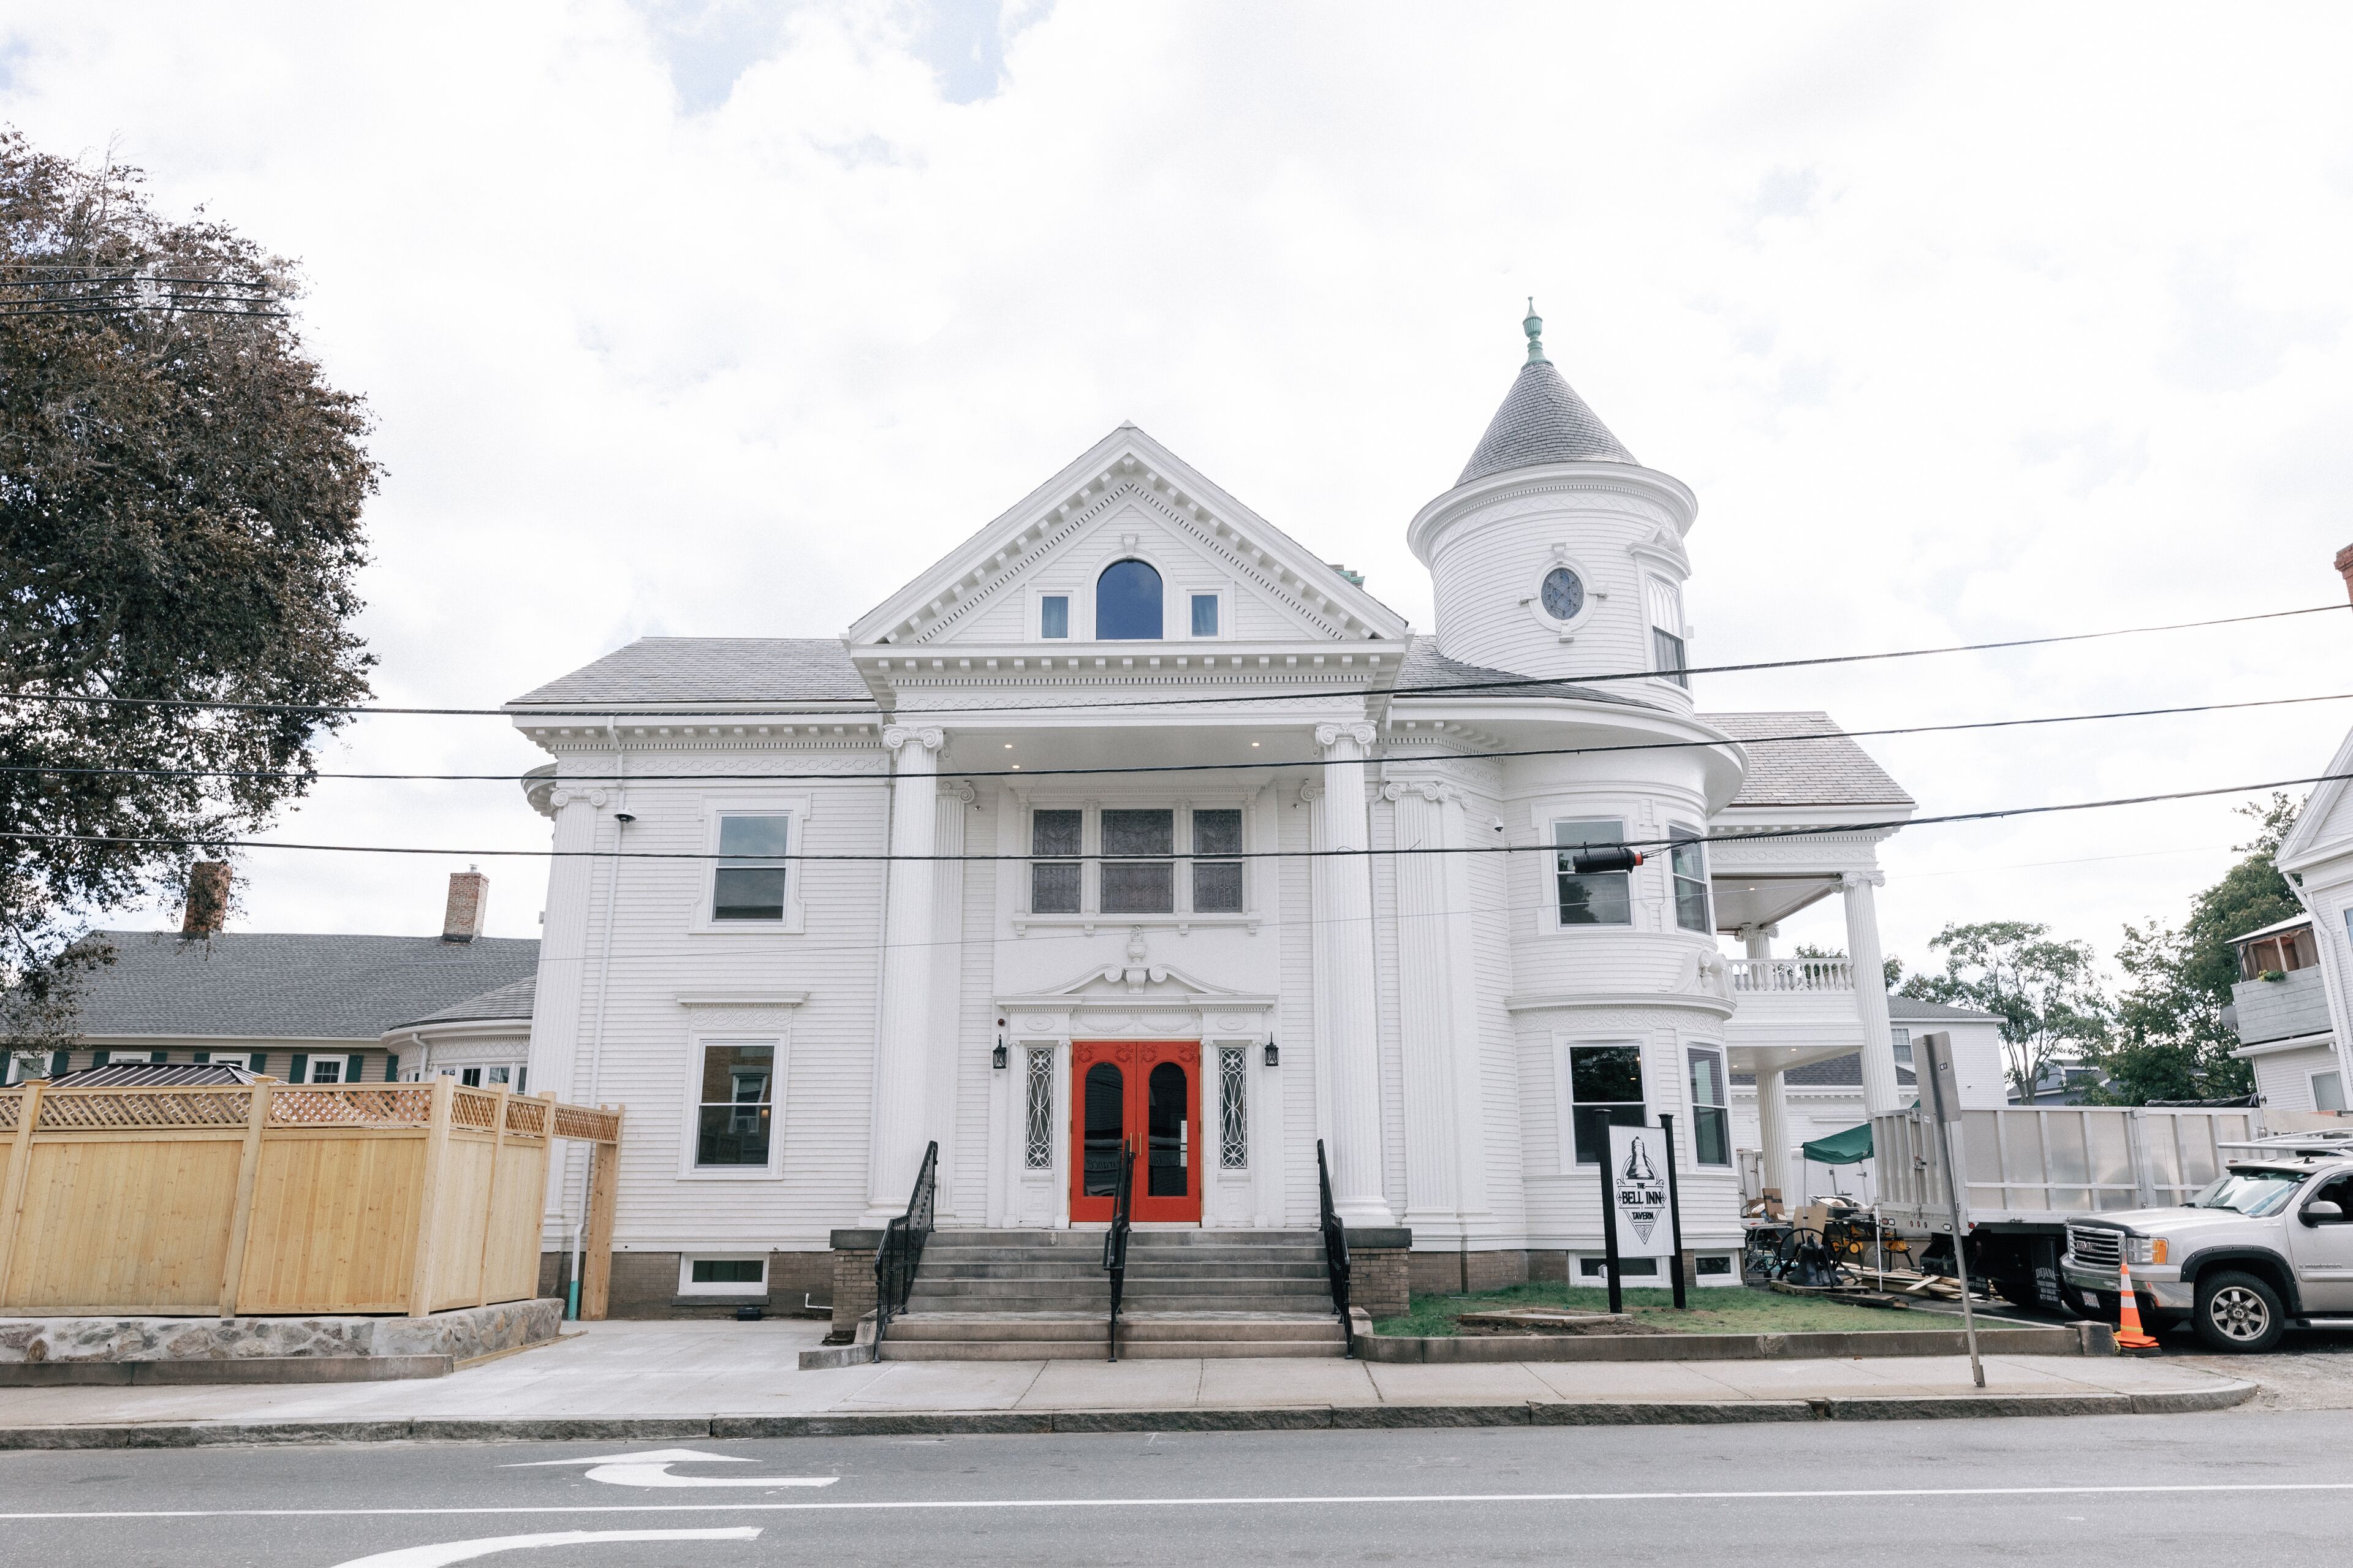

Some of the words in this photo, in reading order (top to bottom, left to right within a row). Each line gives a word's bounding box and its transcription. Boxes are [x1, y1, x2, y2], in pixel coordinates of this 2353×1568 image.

[1621, 1191, 1643, 1204] BELL
[1645, 1191, 1662, 1204] INN
[1632, 1211, 1654, 1220] TAVERN
[2076, 1240, 2099, 1253] GMC
[2035, 1267, 2056, 1281] DEJANA
